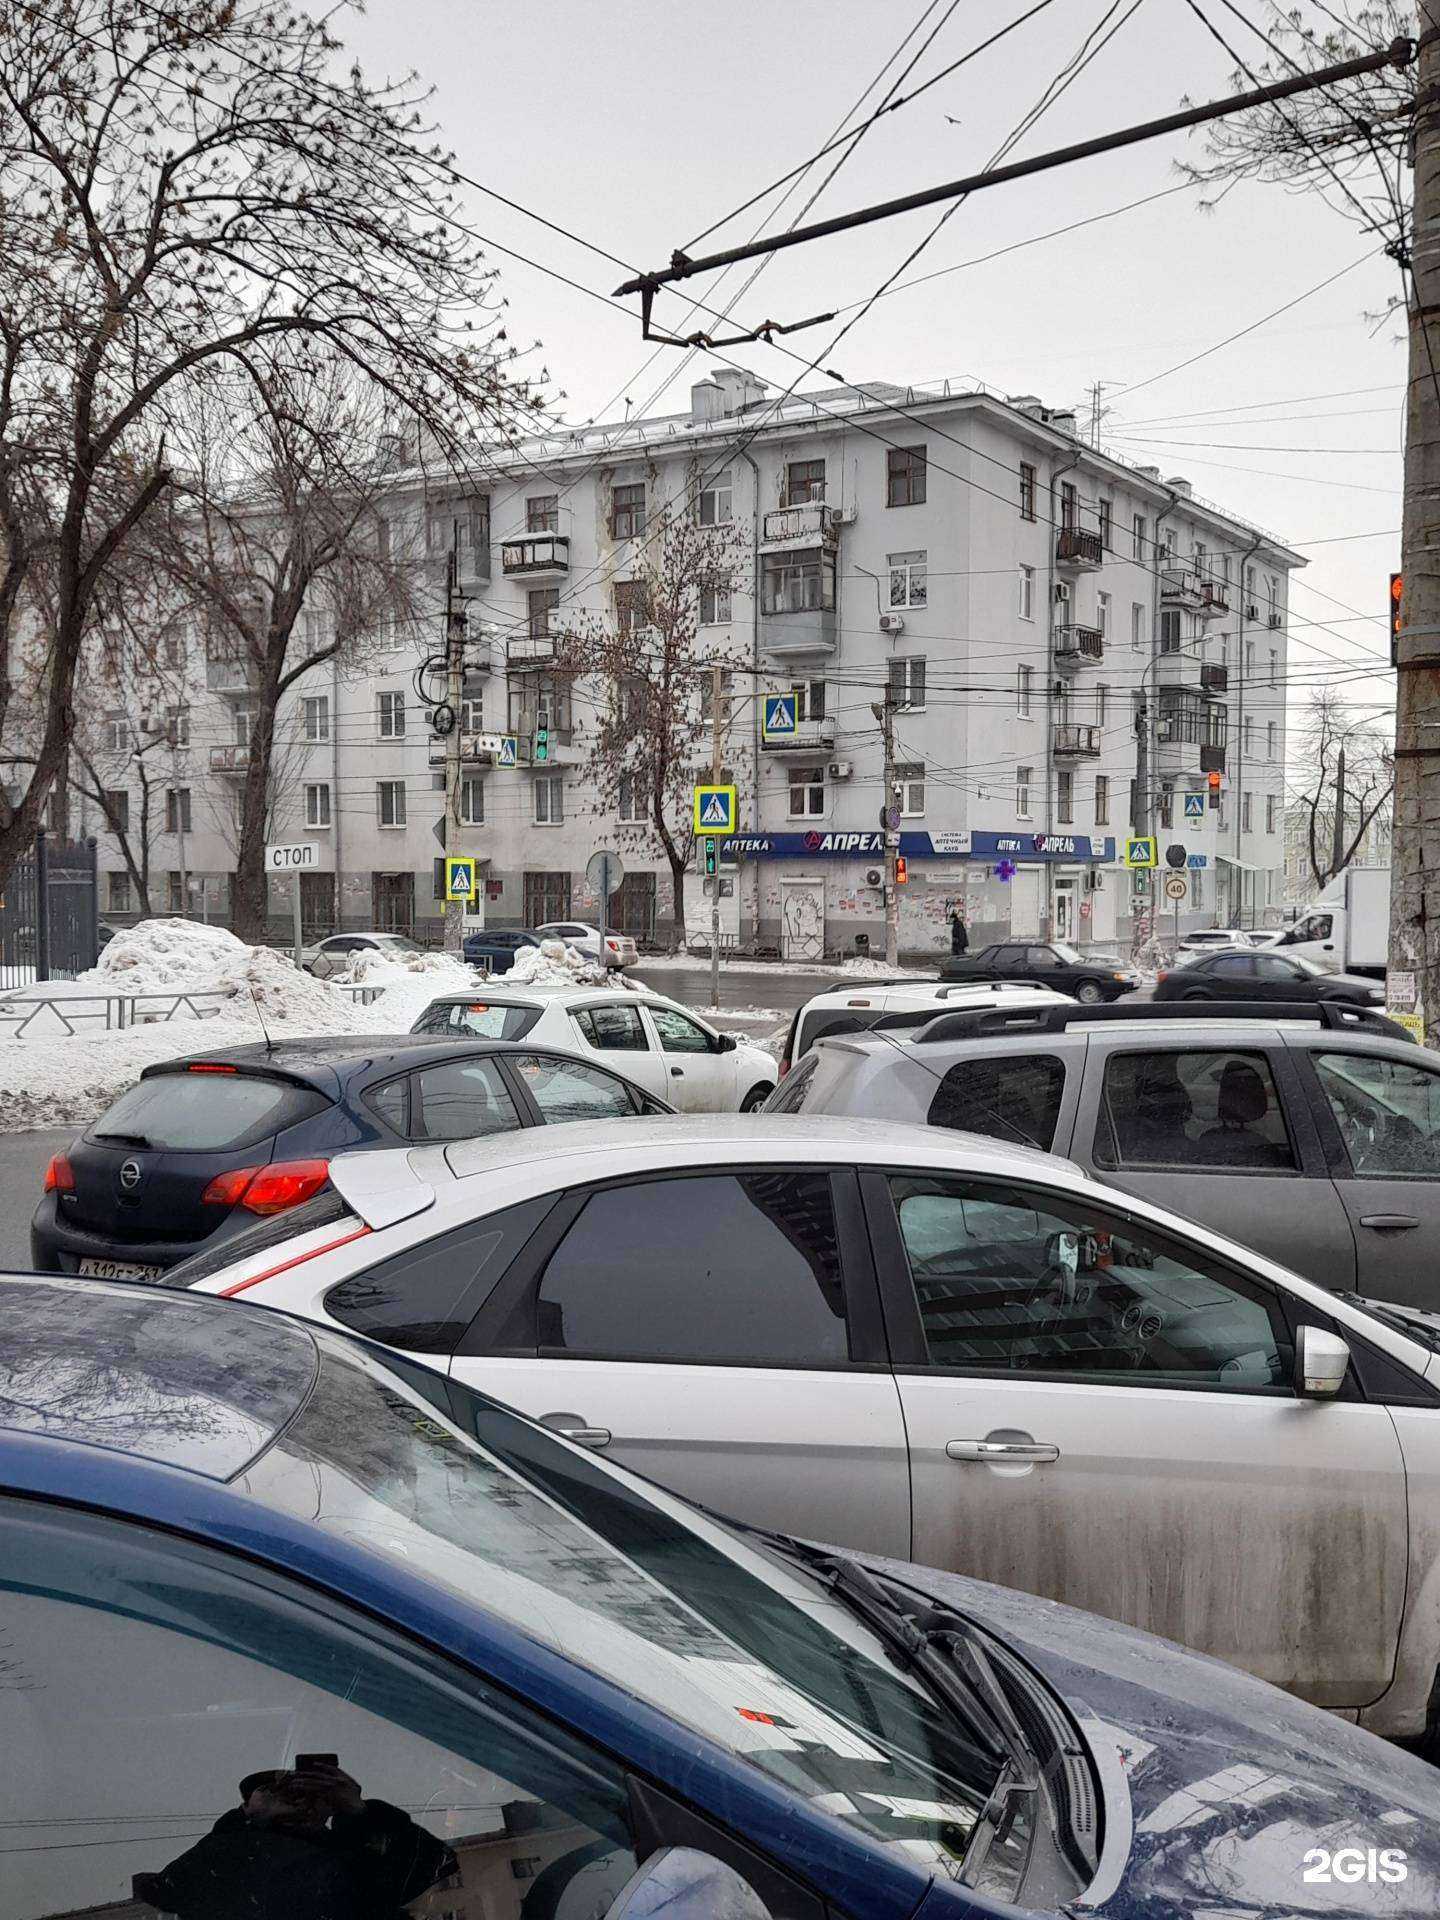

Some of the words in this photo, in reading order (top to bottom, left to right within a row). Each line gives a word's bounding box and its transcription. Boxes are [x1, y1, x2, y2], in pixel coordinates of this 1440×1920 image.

[723, 839, 770, 852] АПТЕКА
[819, 834, 886, 851] АПРЕЛ
[1043, 836, 1075, 853] АПРЕЛЬ
[273, 847, 312, 866] СТОП
[1170, 885, 1182, 893] 40
